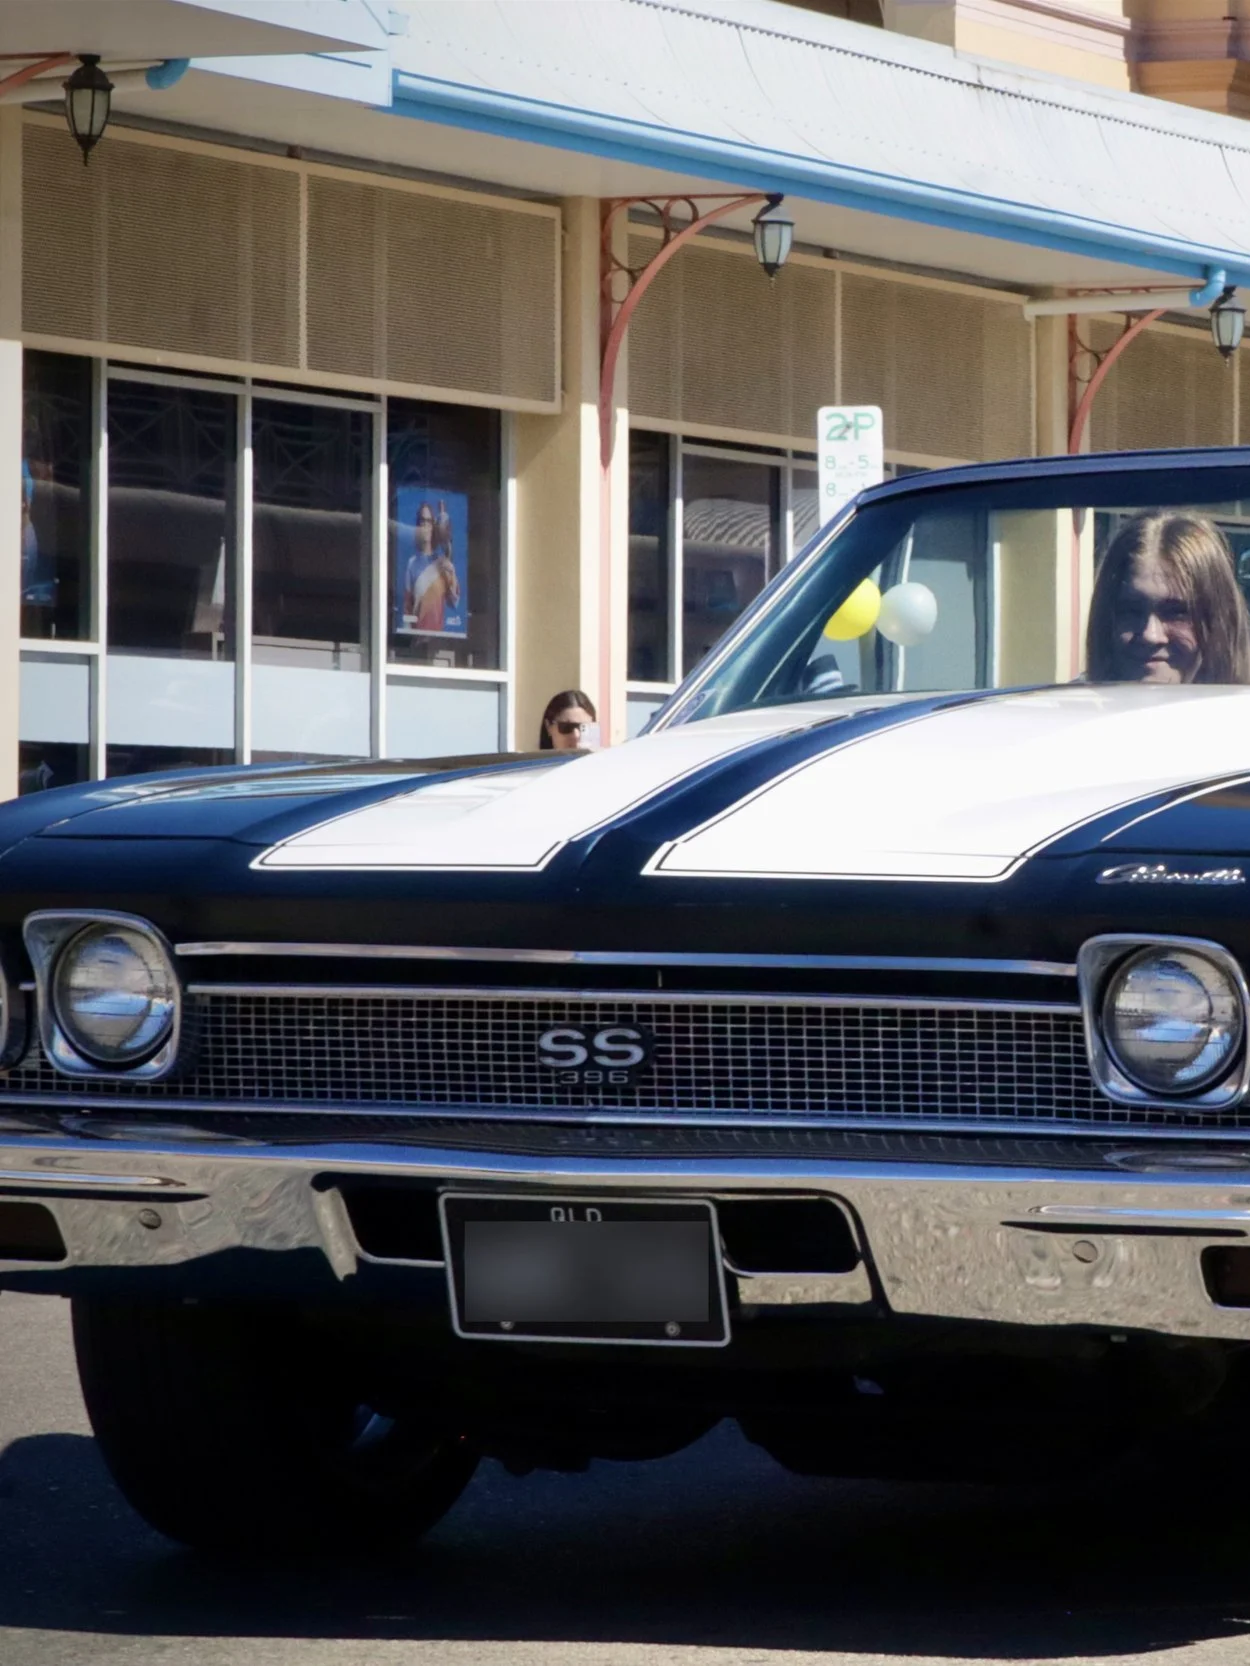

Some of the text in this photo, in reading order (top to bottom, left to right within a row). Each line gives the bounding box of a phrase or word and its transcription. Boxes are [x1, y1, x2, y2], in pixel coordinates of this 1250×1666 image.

[825, 412, 875, 441] 2P
[539, 1028, 645, 1068] SS
[559, 1070, 630, 1085] 396
